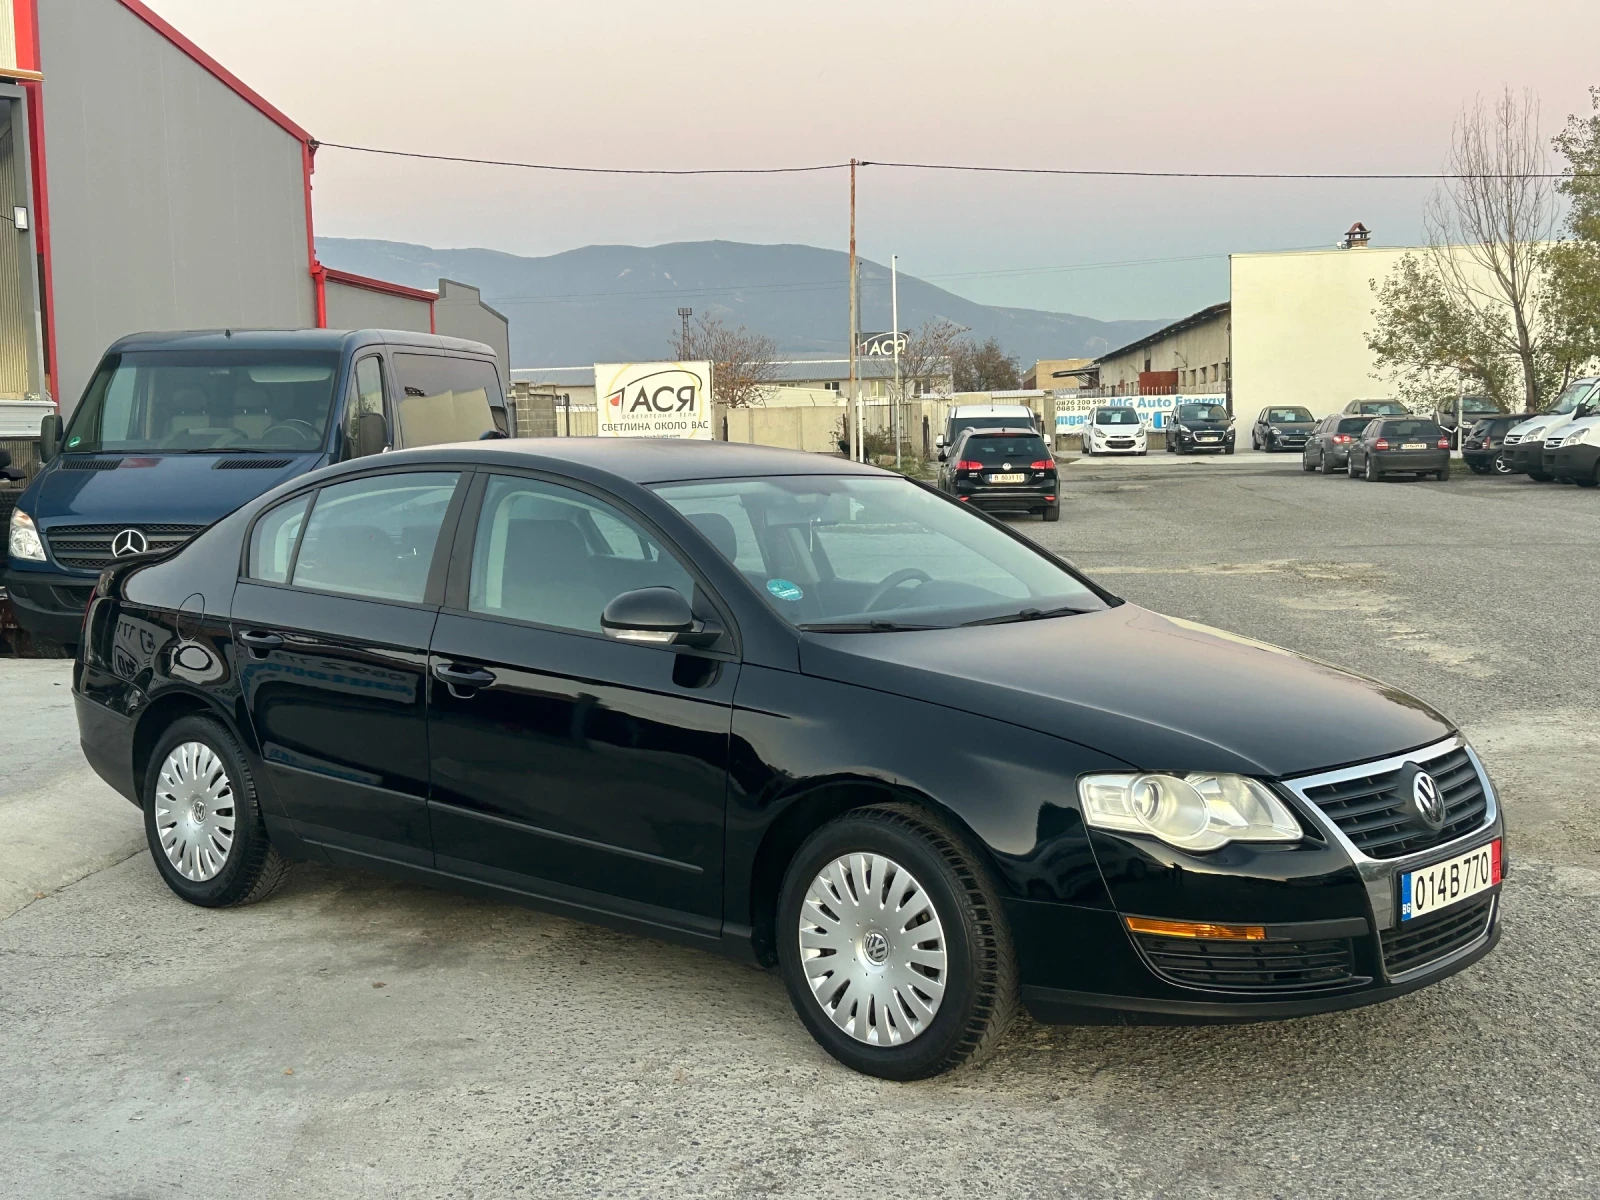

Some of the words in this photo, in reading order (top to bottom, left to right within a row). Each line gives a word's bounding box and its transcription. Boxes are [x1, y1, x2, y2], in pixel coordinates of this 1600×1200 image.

[629, 385, 696, 413] АСЯ
[1109, 398, 1133, 407] MG
[1136, 397, 1172, 408] Auto
[601, 422, 651, 432] СВЕТЛИНА
[654, 421, 687, 430] ОКОЛО
[691, 420, 709, 429] ВАС
[1415, 851, 1489, 911] 014B770
[1402, 903, 1411, 915] BG
